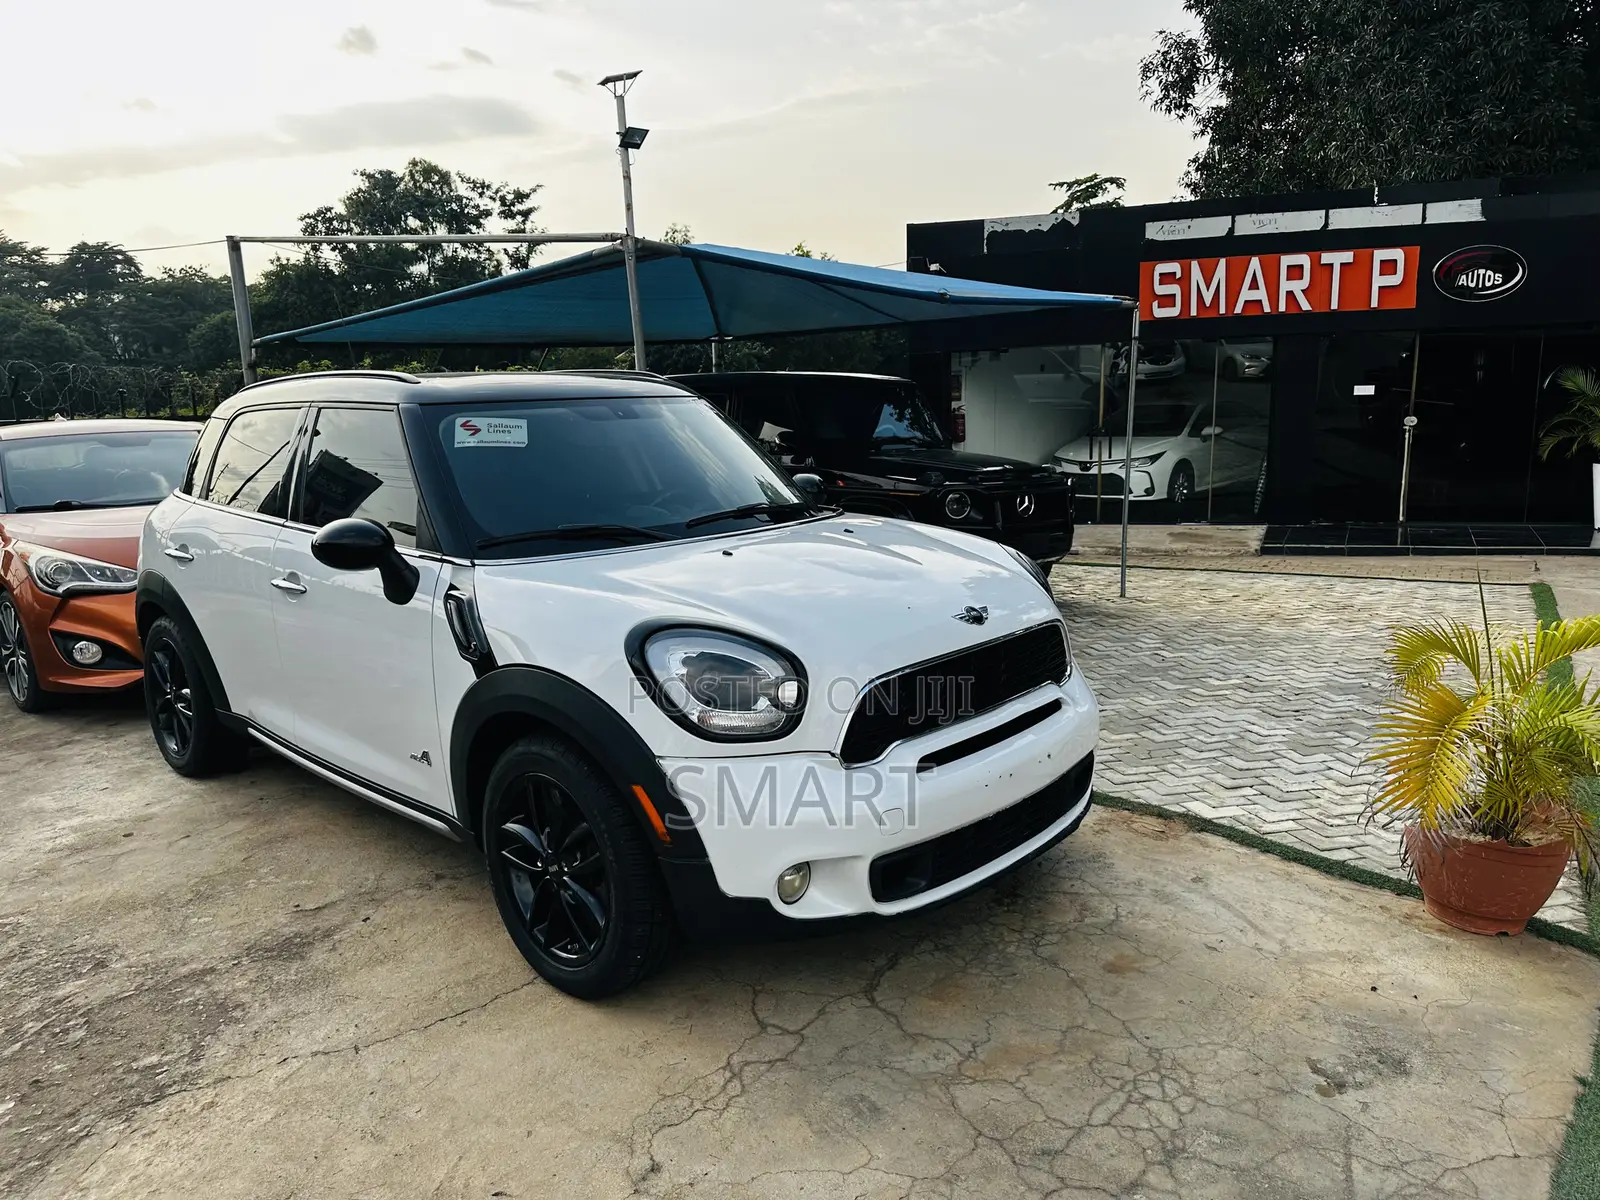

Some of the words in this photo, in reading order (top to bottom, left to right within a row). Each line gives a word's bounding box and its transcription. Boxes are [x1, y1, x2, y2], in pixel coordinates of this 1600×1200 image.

[1152, 251, 1354, 318] SMART
[1370, 248, 1405, 308] P
[1458, 268, 1503, 288] AUTOS
[486, 422, 523, 430] Sallaum
